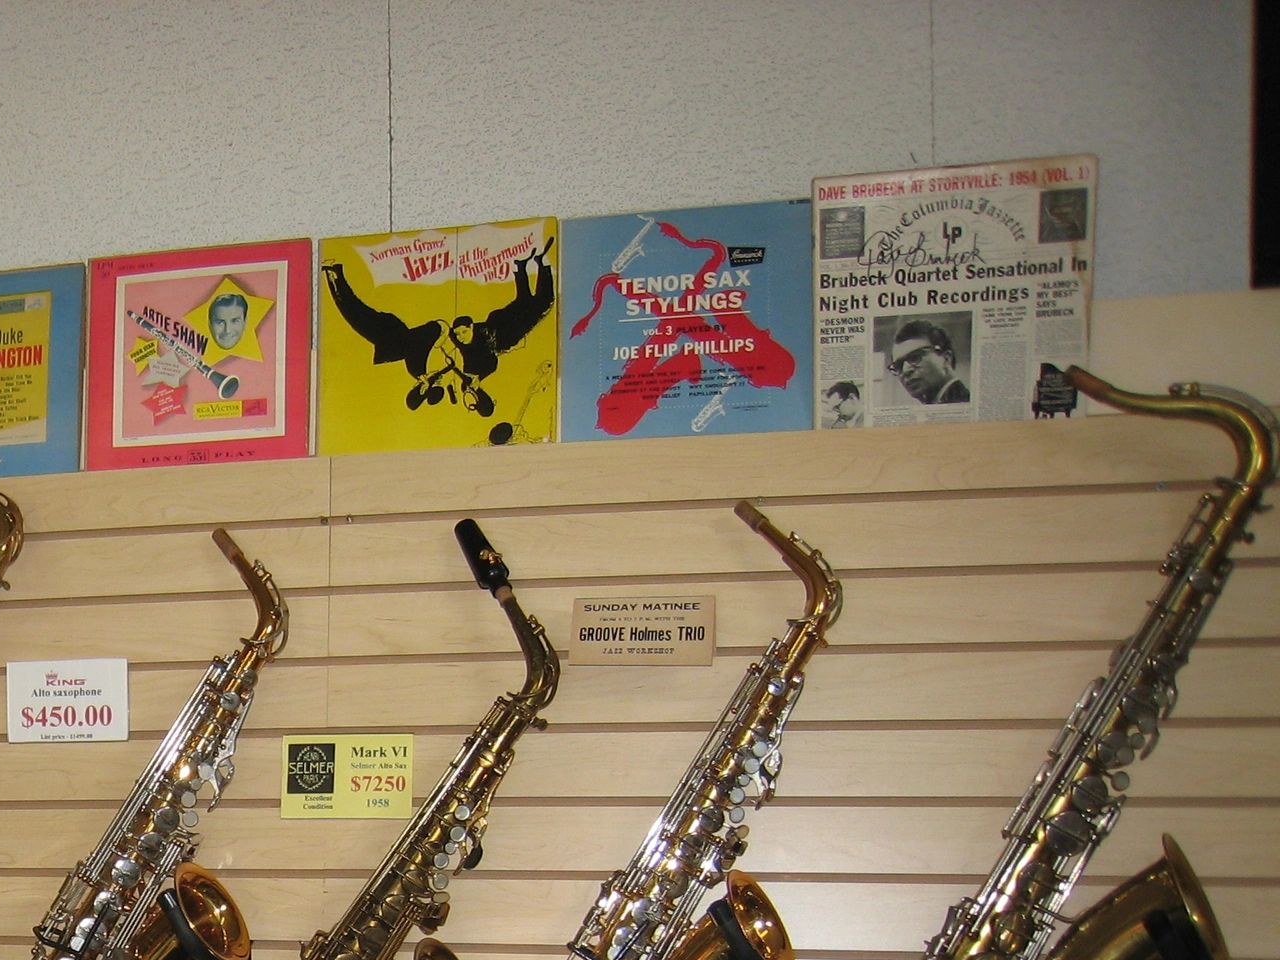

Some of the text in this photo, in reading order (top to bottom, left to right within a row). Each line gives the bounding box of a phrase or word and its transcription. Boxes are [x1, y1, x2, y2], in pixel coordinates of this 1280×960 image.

[818, 186, 846, 201] DAVE
[852, 180, 905, 198] BRUBECK
[911, 179, 924, 193] AT
[1010, 170, 1037, 185] 1954
[369, 244, 412, 264] Norman
[458, 247, 488, 266] at the
[458, 236, 534, 280] Philharmonic
[402, 251, 455, 282] Jazz
[820, 257, 1087, 289] Brubeck Quartet Sensational In
[617, 269, 751, 295] TENOR SAX
[626, 291, 743, 316] STYLINGS
[819, 285, 1030, 314] Night Club Recordings
[142, 305, 209, 356] ARTIE SHAW
[642, 328, 663, 336] VOL.
[665, 325, 673, 336] 3
[676, 326, 711, 334] PLAYED
[612, 338, 755, 360] JOE FLIP PHILLIPS
[584, 602, 701, 612] SUNDAY MATINEE
[579, 625, 705, 642] GROOVE Holmes TRIO
[32, 688, 102, 699] Alto saxophone
[21, 704, 112, 729] $450.00
[351, 745, 407, 758] Mark VI
[288, 761, 334, 774] SELMER
[350, 775, 406, 792] $7250
[366, 798, 390, 808] 1958
